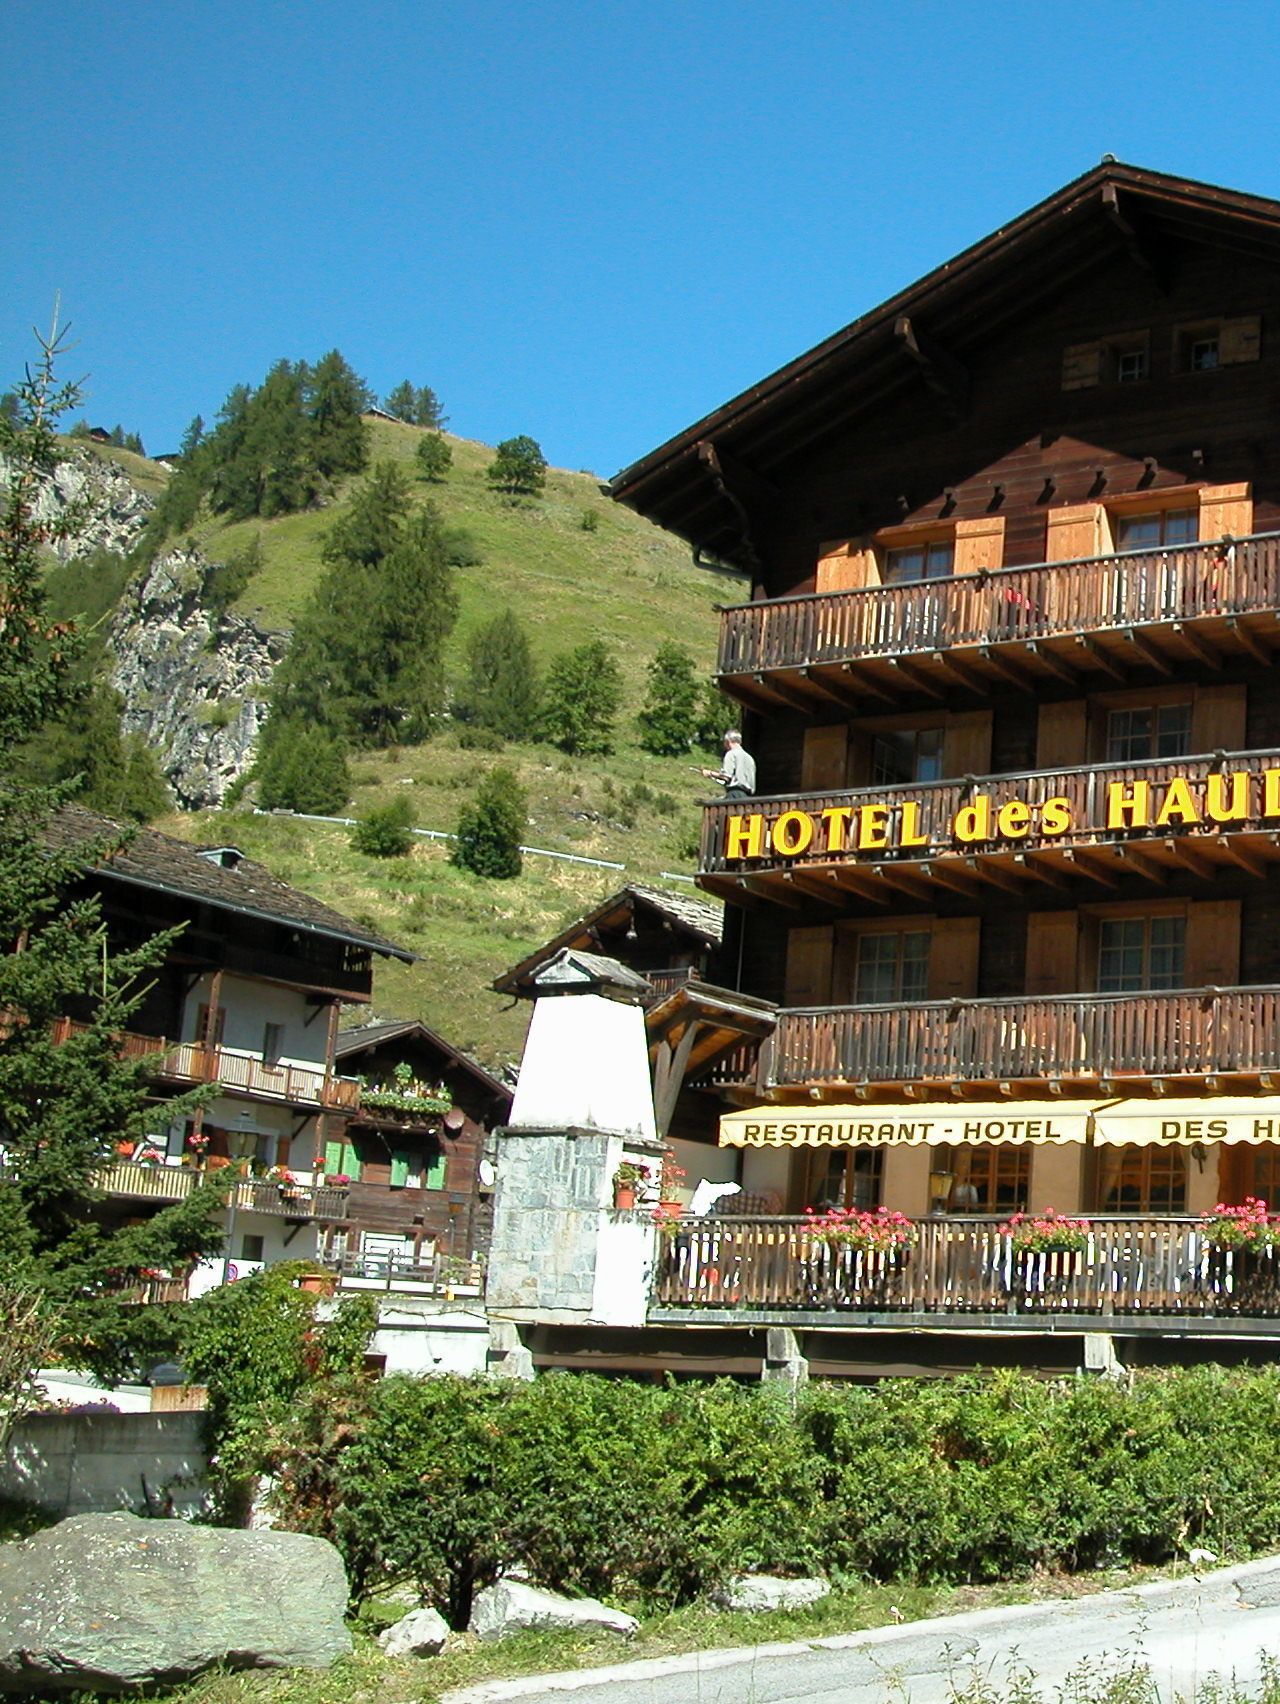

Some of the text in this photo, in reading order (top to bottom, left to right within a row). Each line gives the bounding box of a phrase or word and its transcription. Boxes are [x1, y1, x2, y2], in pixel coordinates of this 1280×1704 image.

[726, 801, 928, 860] HOTEL
[954, 795, 1072, 842] des
[743, 1122, 934, 1142] RESTAURANT
[963, 1120, 1061, 1140] HOTEL
[1161, 1120, 1228, 1139] DES
